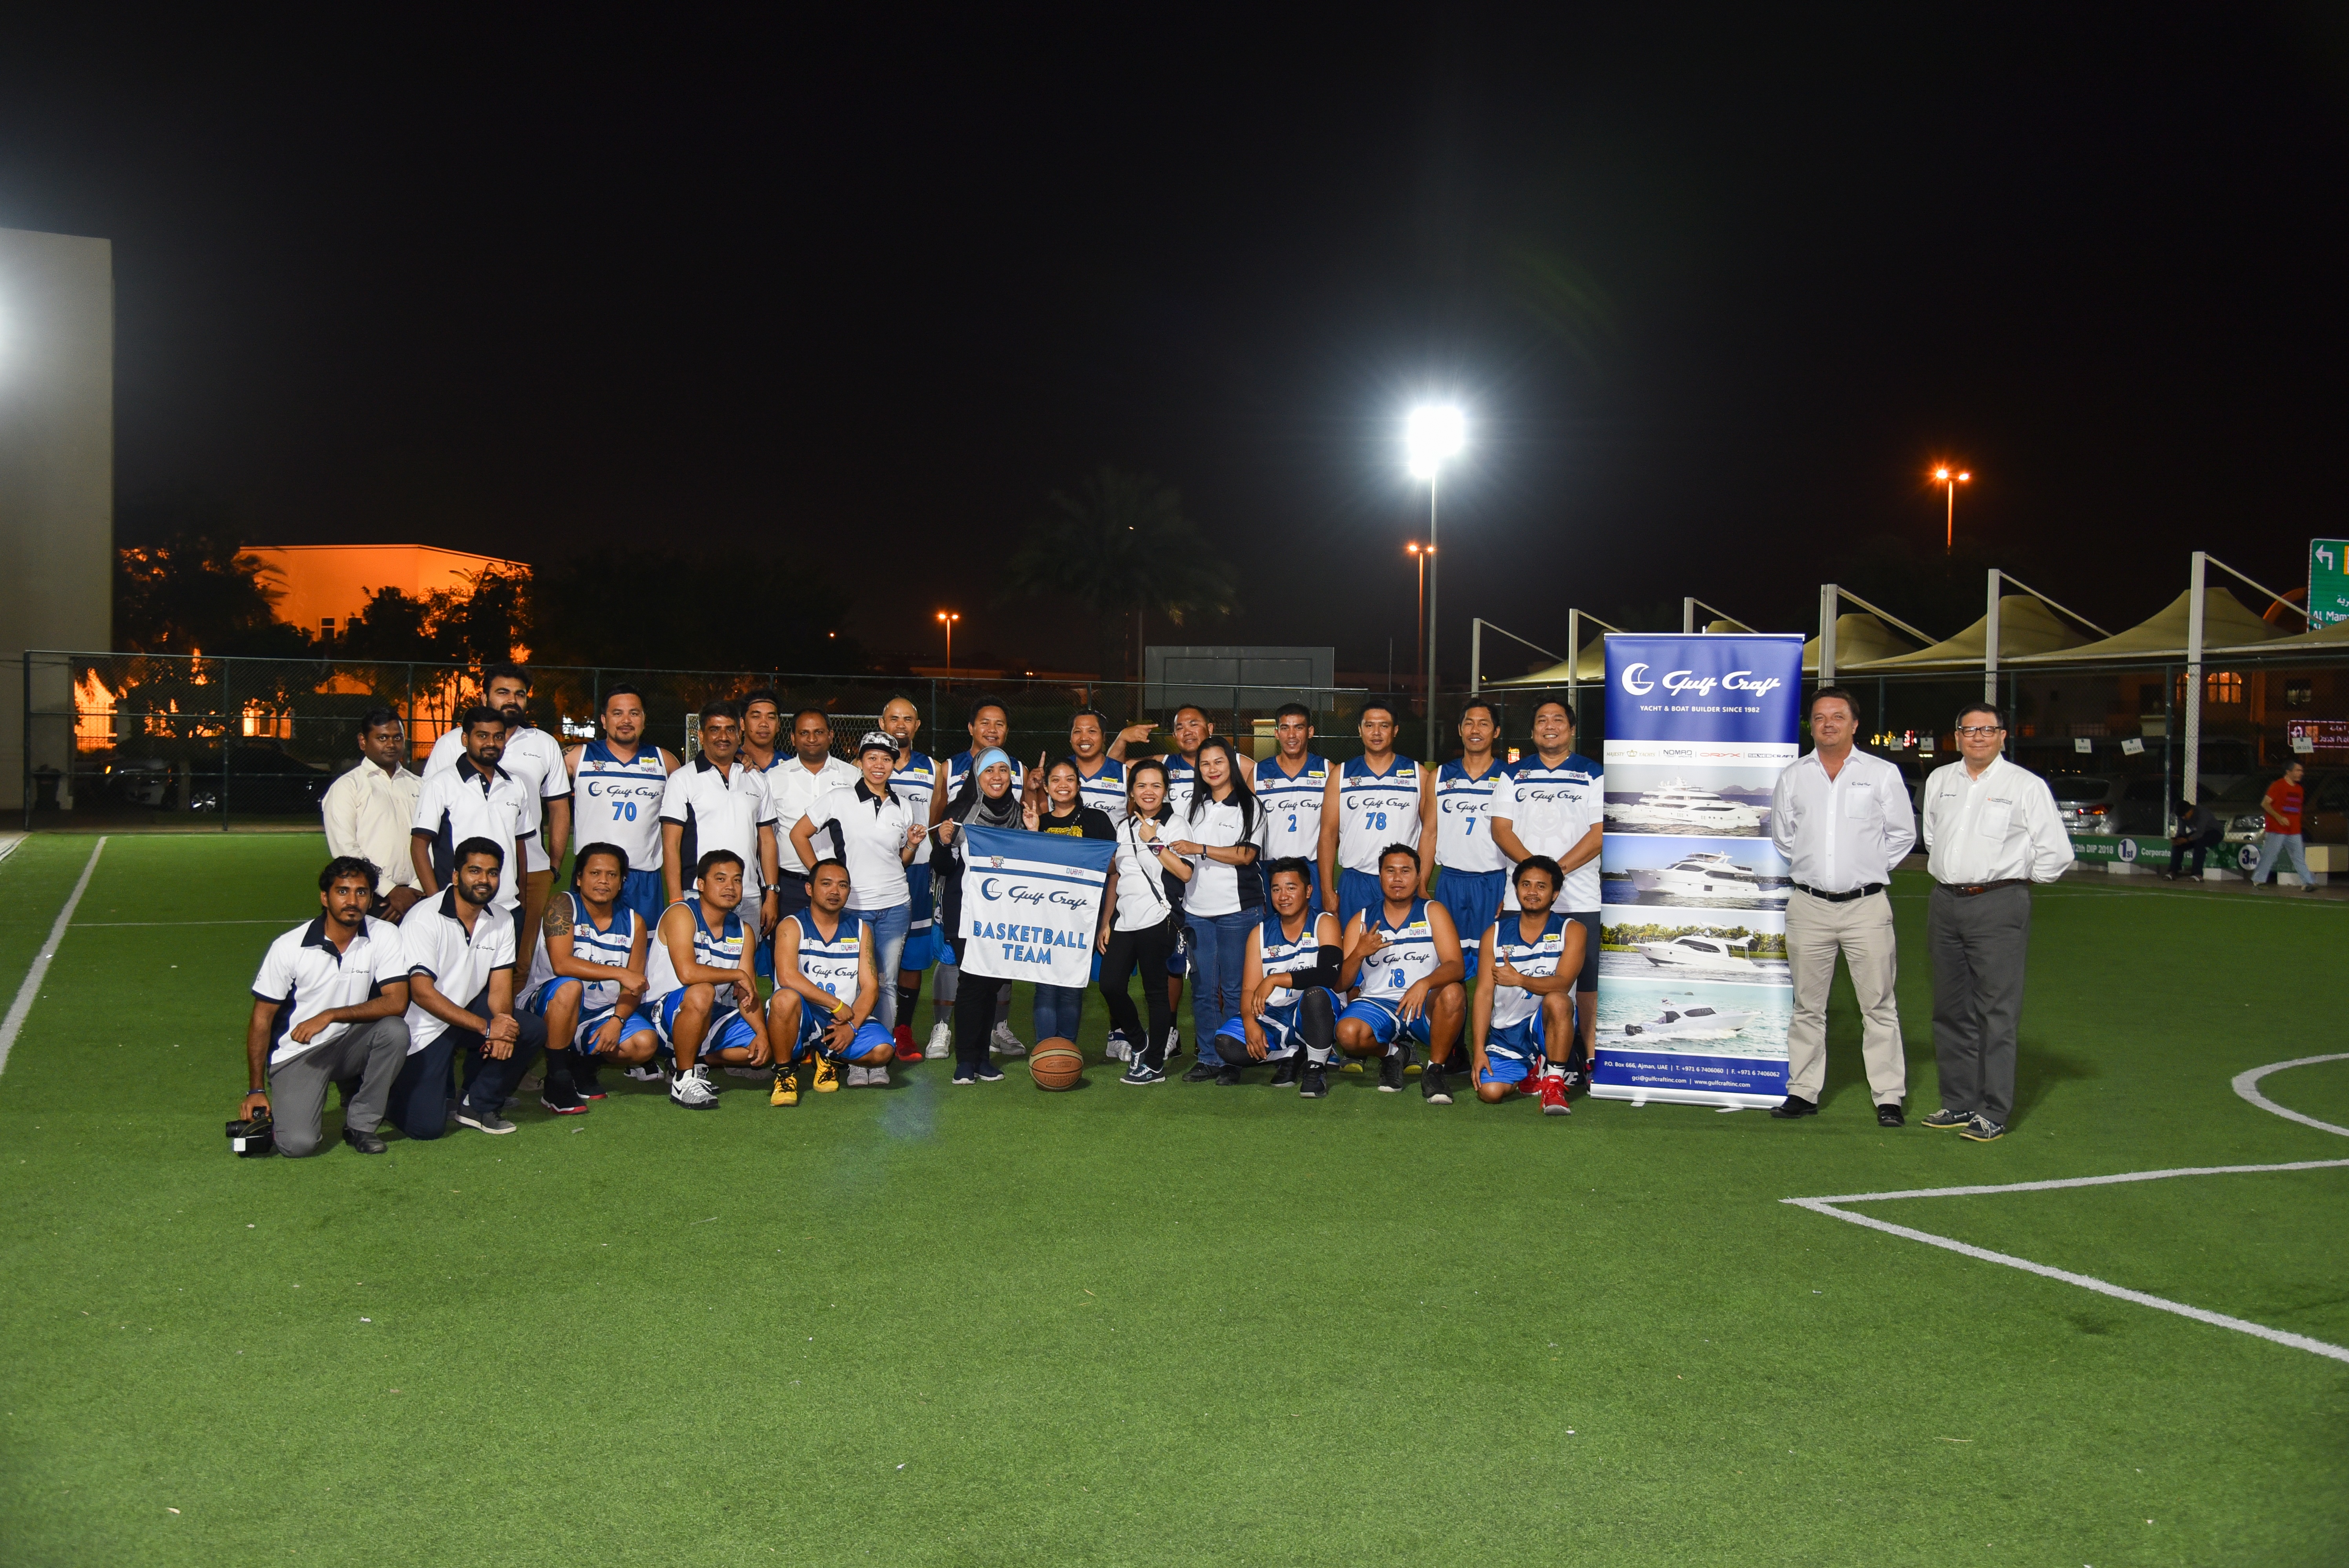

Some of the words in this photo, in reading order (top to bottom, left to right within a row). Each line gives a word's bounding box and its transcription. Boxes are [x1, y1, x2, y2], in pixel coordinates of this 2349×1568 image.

[2326, 611, 2349, 622] Mam
[1663, 671, 1717, 696] Gulf
[1722, 671, 1781, 697] Craft
[606, 786, 632, 797] Gulf
[1093, 801, 1116, 813] Craft
[1386, 798, 1410, 810] Craft
[1456, 801, 1477, 813] Gulf
[612, 801, 637, 821] 70
[1288, 814, 1297, 832] 2
[1365, 812, 1387, 831] 78
[1466, 817, 1476, 835] 7
[2086, 844, 2097, 853] DIP
[2098, 845, 2114, 854] 2018
[2121, 840, 2133, 858] 1st
[2141, 847, 2172, 858] Corporate
[2242, 849, 2257, 865] 3rd
[1066, 867, 1084, 876] DUBAI
[1008, 886, 1045, 905] Gulf
[1049, 891, 1087, 910] Craft
[973, 920, 1087, 949] BASKETBALL
[724, 945, 741, 953] DUBAI
[1002, 944, 1051, 965] TEAM
[1404, 952, 1430, 963] Craft
[812, 965, 832, 978] Gulf
[1694, 1079, 1750, 1088] www.gulfcraftinc.com
